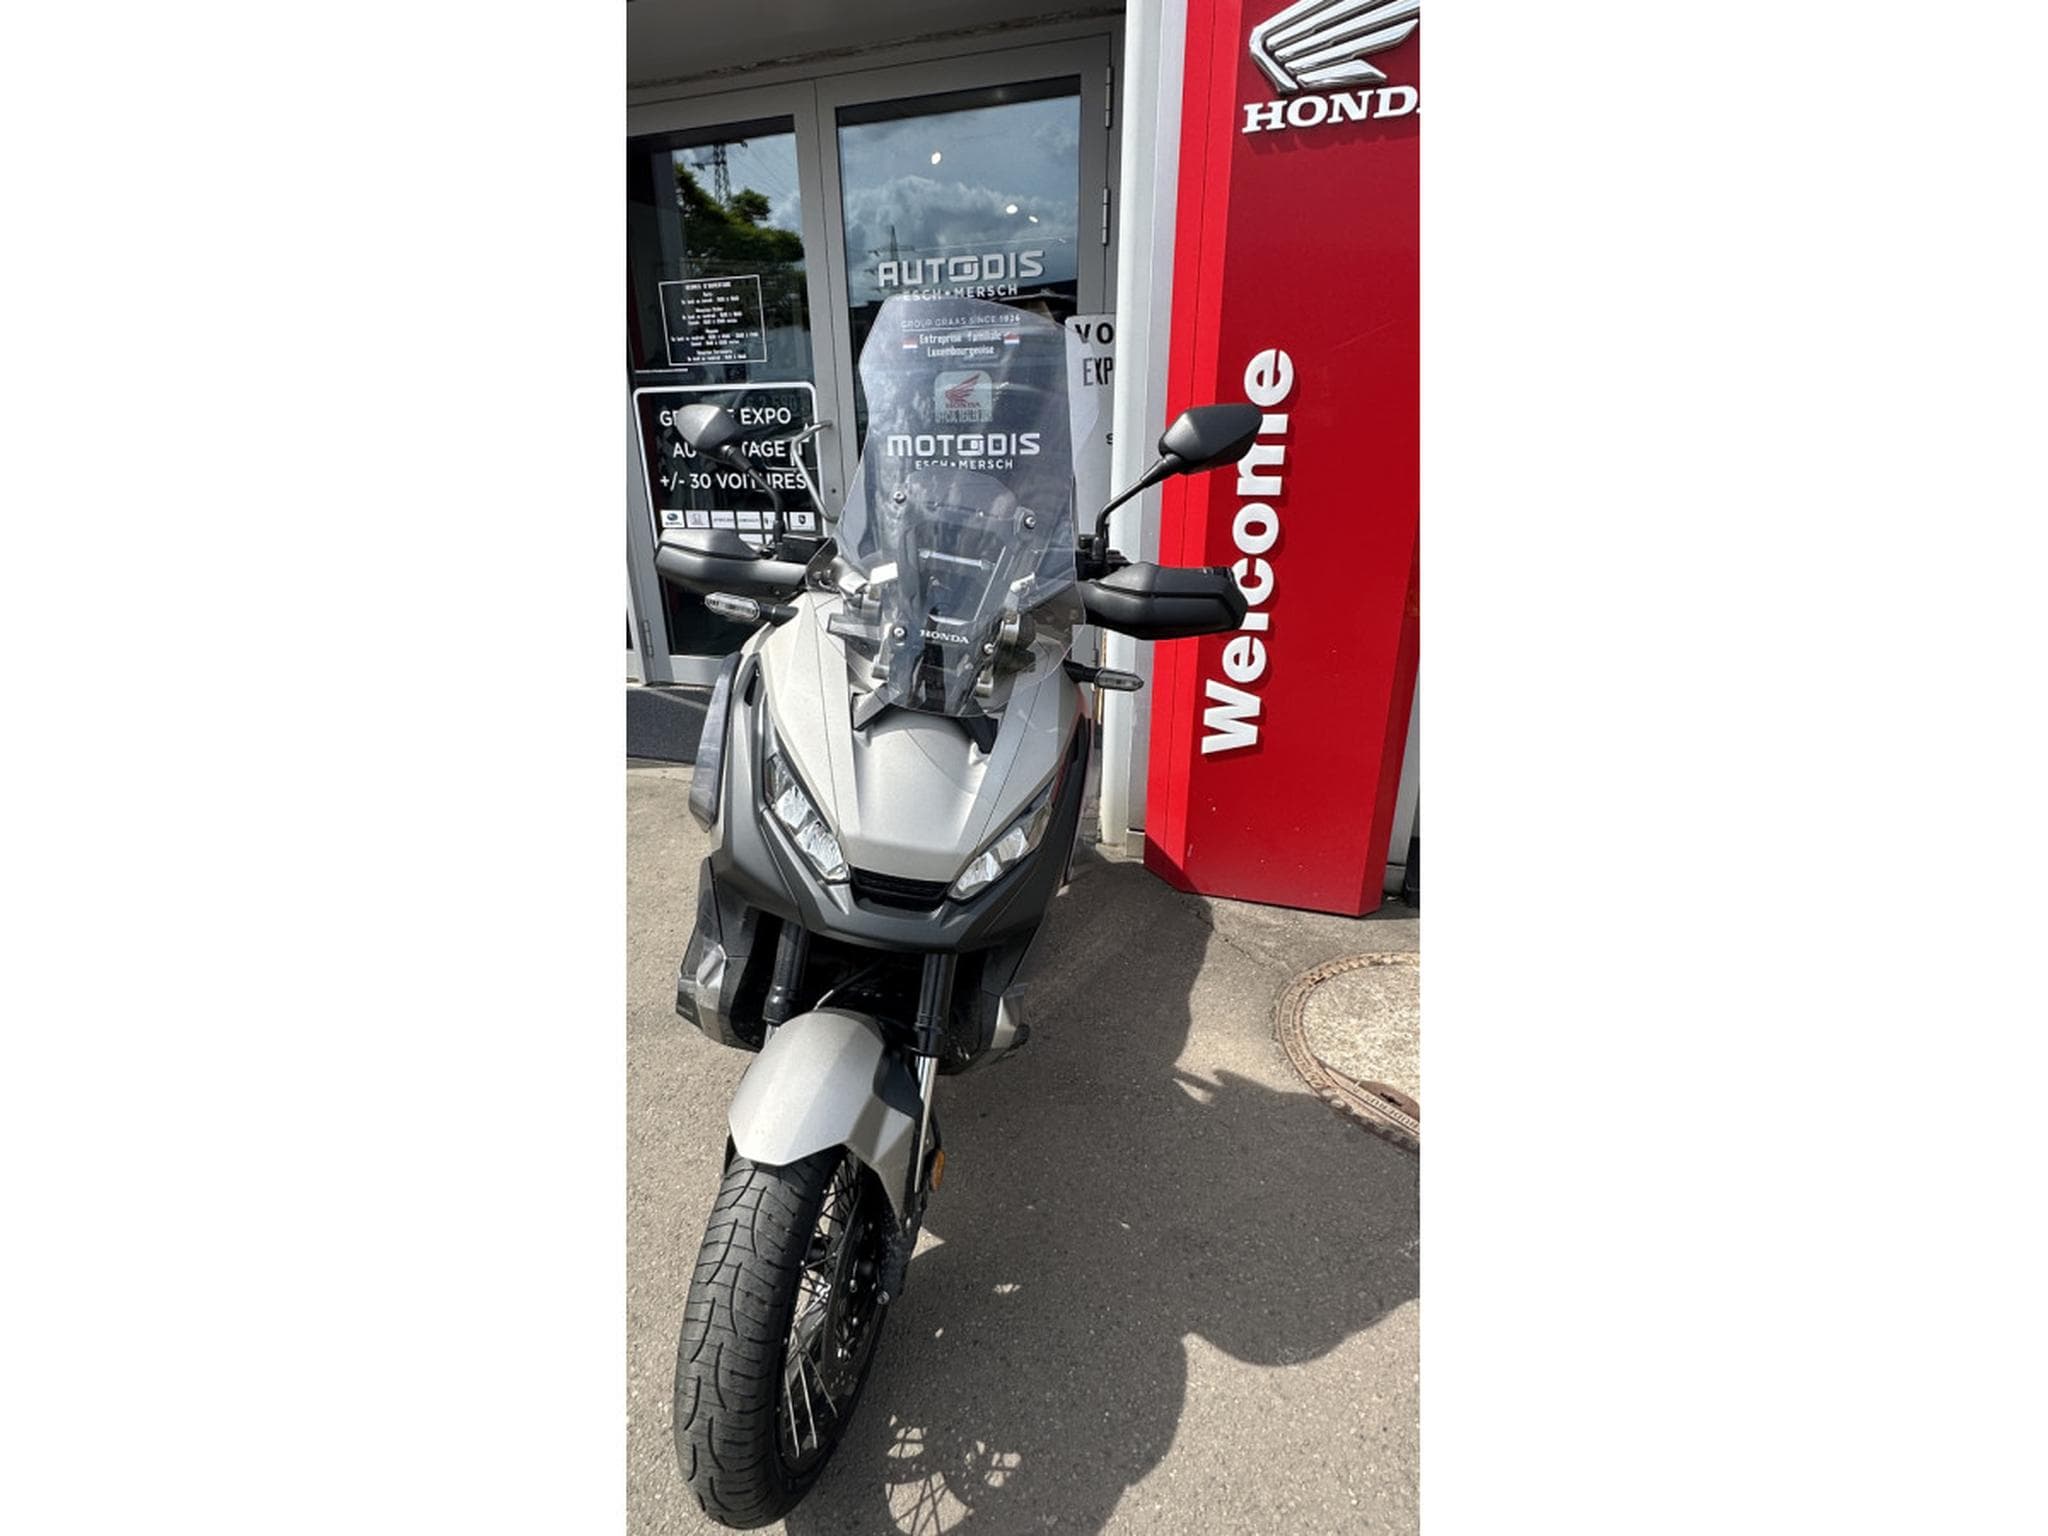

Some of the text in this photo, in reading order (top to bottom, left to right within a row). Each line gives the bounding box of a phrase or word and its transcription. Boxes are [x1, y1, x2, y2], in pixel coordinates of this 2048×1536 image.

[1241, 85, 1420, 134] HOND
[878, 250, 1045, 288] AUTODIS
[740, 407, 791, 425] EXPO
[887, 432, 1041, 457] MOTODIS
[689, 473, 712, 489] 30
[920, 629, 969, 644] HONDA
